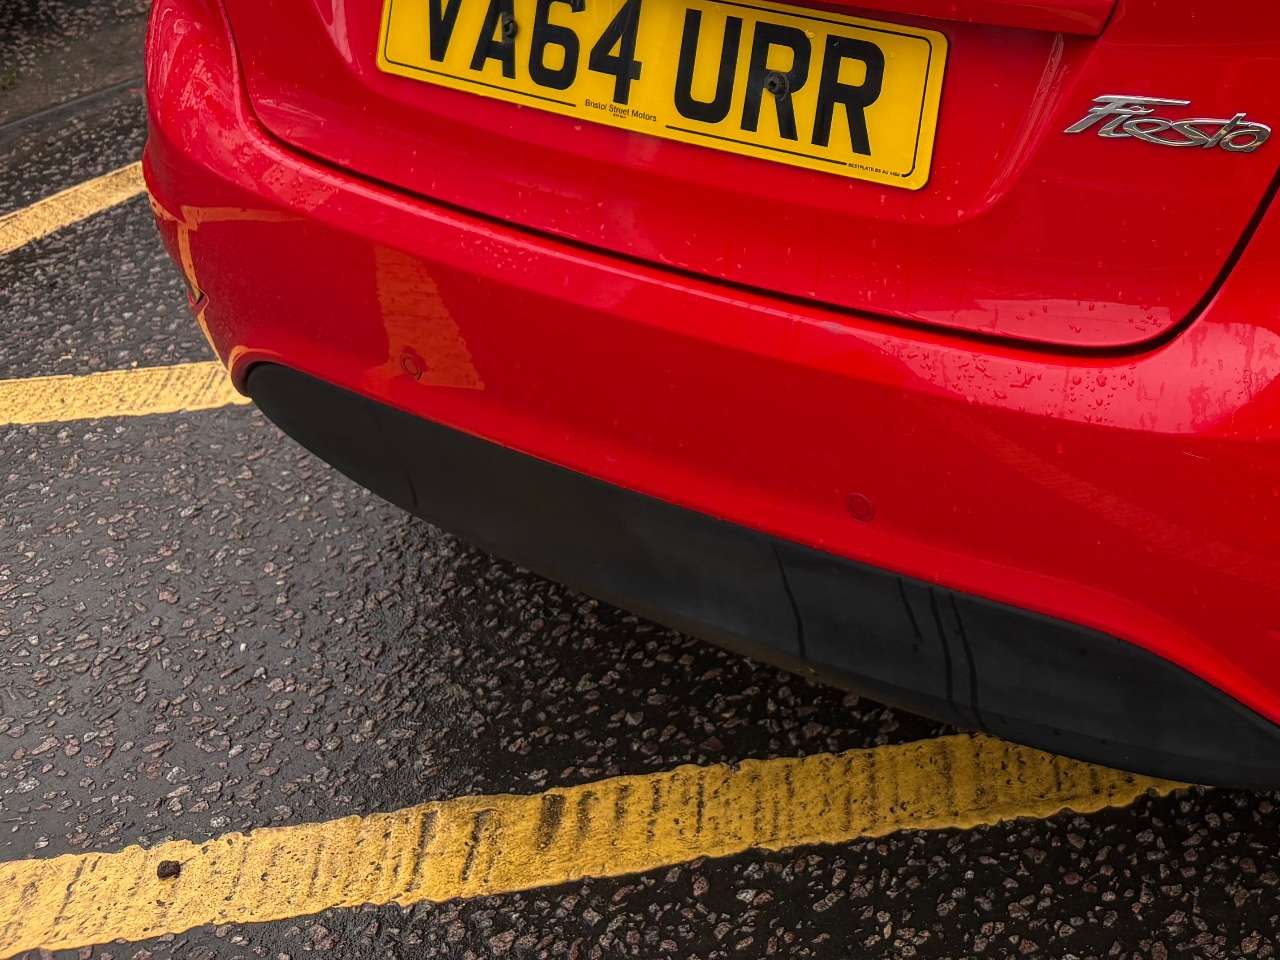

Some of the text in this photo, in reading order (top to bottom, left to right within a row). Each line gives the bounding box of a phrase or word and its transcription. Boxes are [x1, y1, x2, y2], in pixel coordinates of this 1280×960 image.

[674, 8, 885, 156] URR
[608, 104, 630, 116] Street
[632, 110, 657, 121] Motors
[1063, 95, 1271, 152] Fiesta
